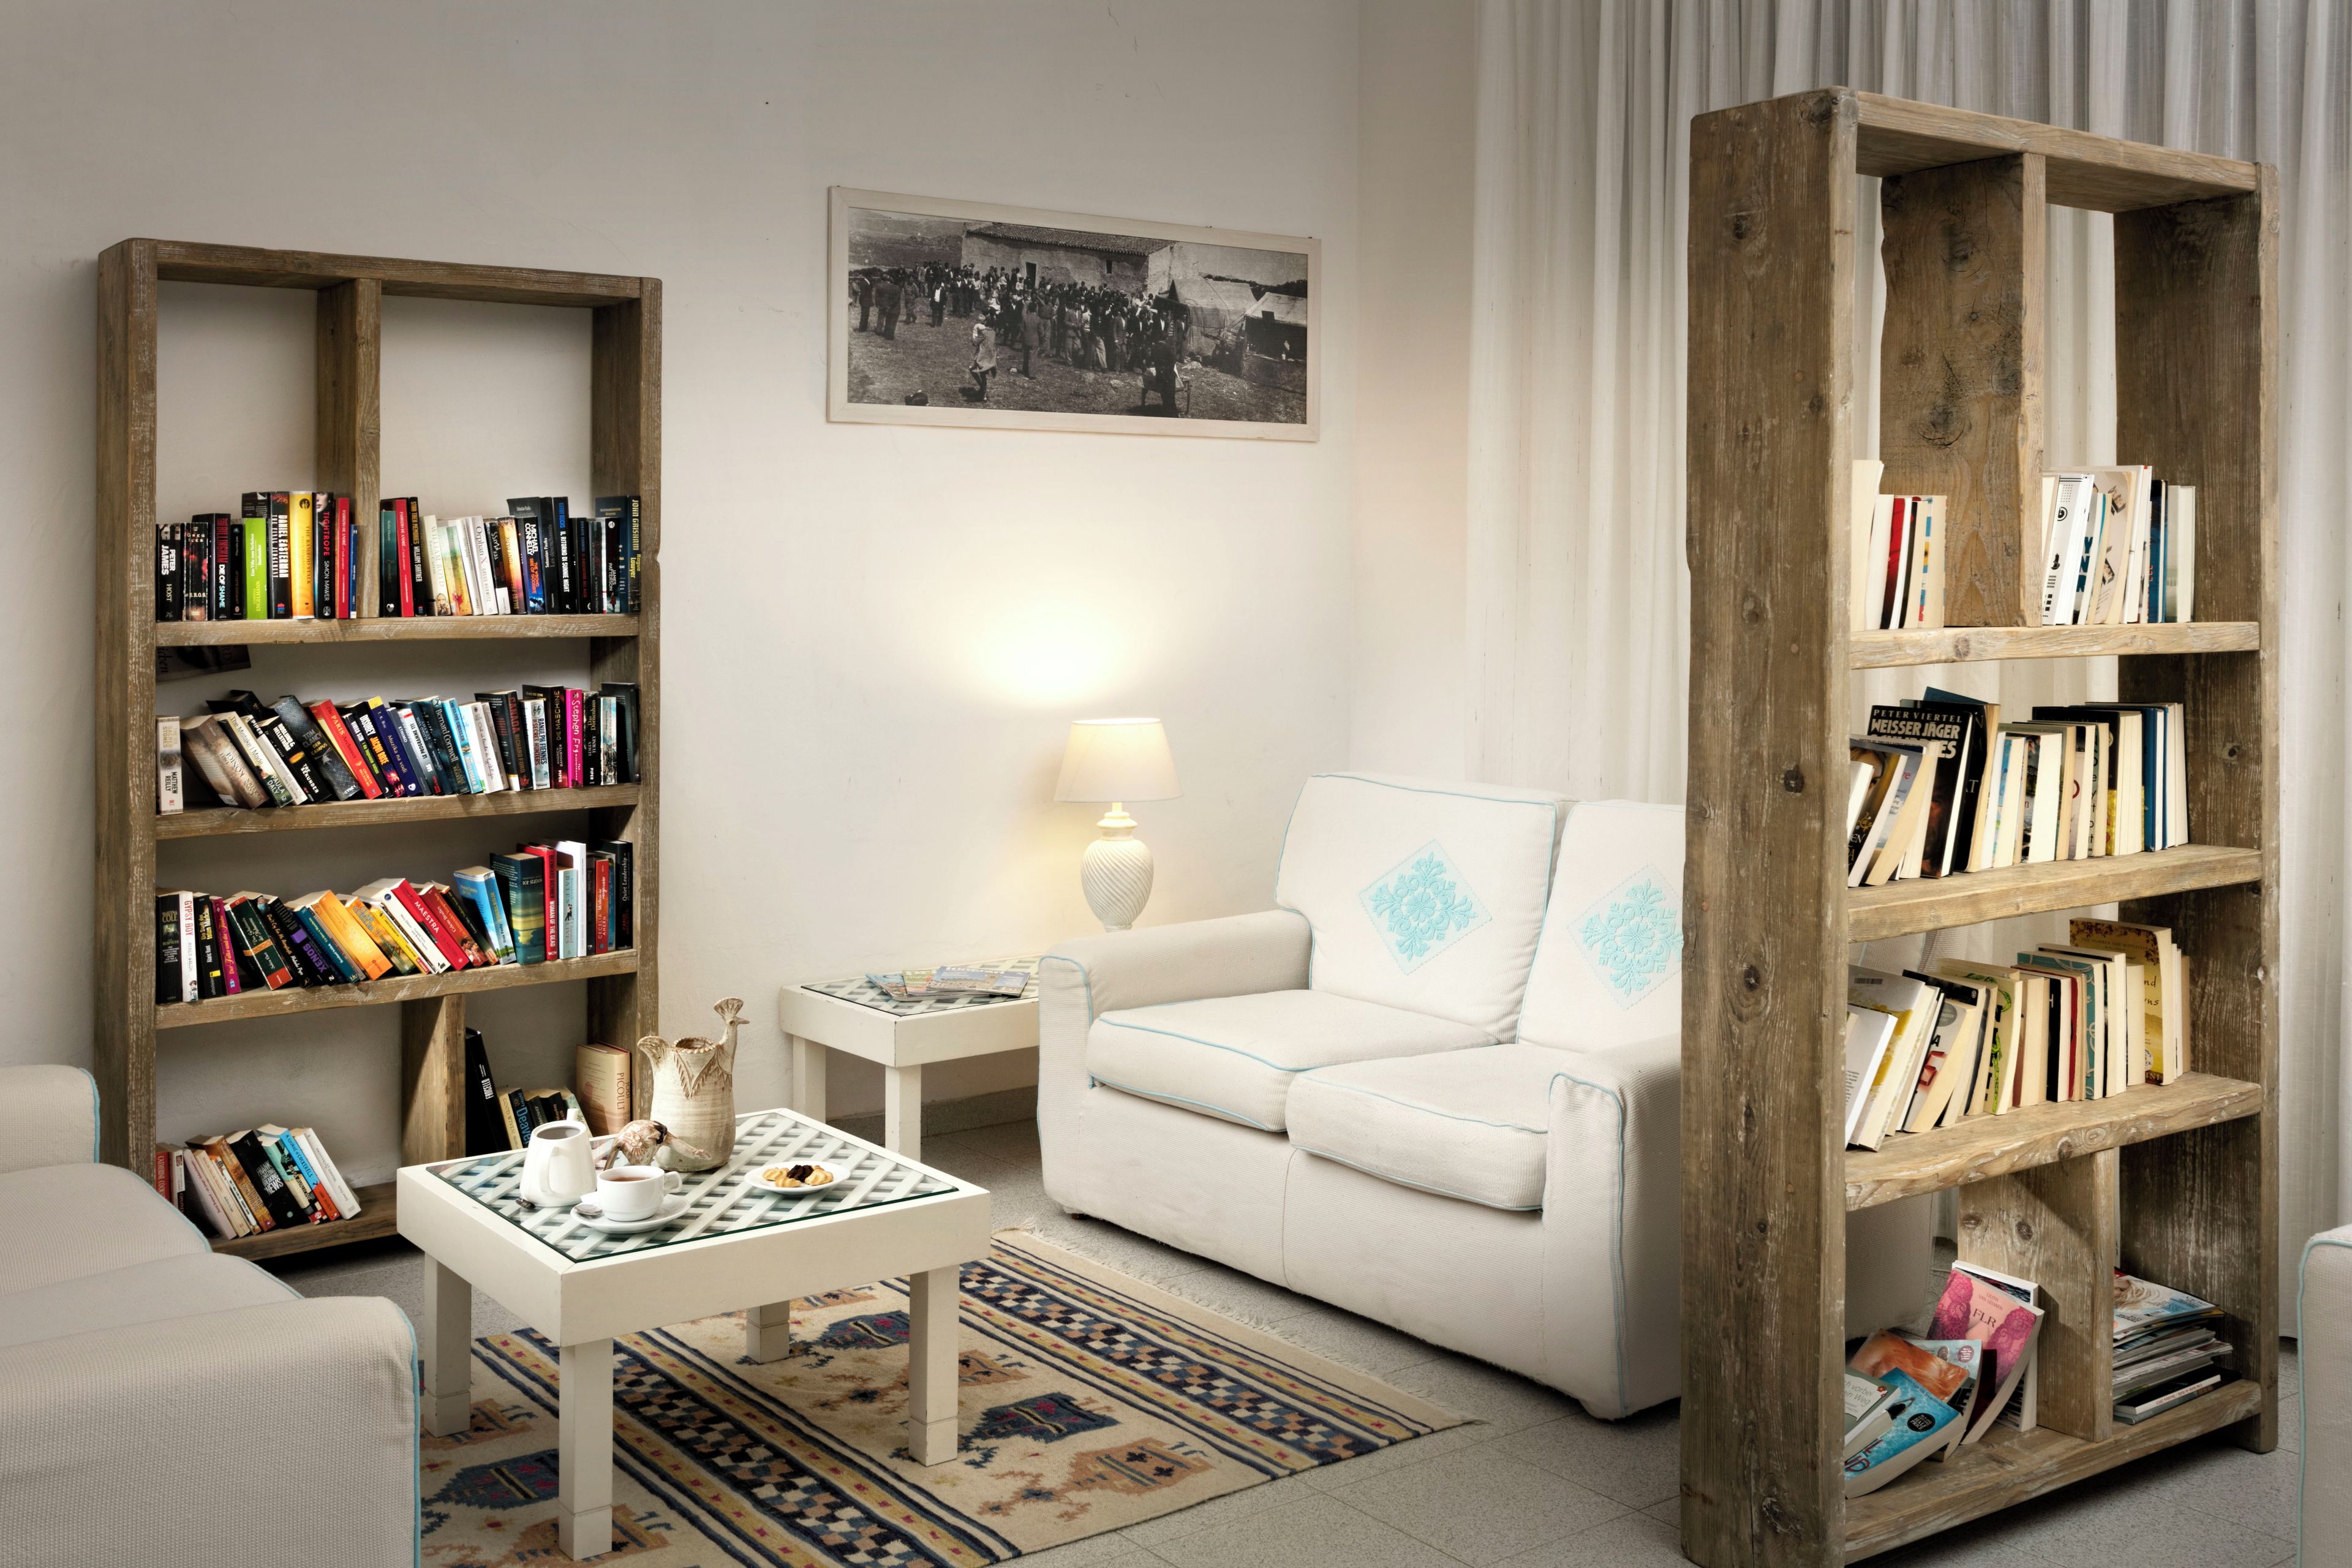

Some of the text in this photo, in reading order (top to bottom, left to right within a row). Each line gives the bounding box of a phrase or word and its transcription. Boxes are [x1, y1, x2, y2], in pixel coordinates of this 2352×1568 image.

[217, 526, 228, 564] BILLINGHAM
[278, 514, 289, 578] DANIEL EASTERMAN
[431, 526, 442, 561] WILLIAM
[475, 526, 485, 556] Orphan
[492, 532, 502, 551] FLUSS
[524, 522, 533, 556] CONNELLY
[219, 575, 225, 584] OF
[360, 714, 376, 736] DISOBEY
[571, 699, 581, 736] Stephen
[1873, 709, 1962, 723] PETER VIERTEL
[251, 719, 263, 736] PIPER
[277, 723, 292, 744] ROSLUND
[303, 729, 316, 739] TOM
[331, 715, 356, 760] PARIS Architect
[398, 726, 407, 743] ETHIMO
[435, 708, 459, 763] Bernard Cornwell
[508, 696, 520, 733] CANADA
[514, 733, 523, 759] RICHARD
[538, 718, 546, 742] RANULPH
[1871, 718, 1961, 739] WEISSER JÄGER
[231, 716, 263, 765] The Mistake Made
[273, 727, 291, 752] HELLSTRÖM
[302, 731, 322, 748] CLANCY
[311, 743, 328, 756] CAMPUS
[413, 730, 426, 755] PROGRAMME
[370, 736, 390, 766] JACQUI ROSE
[387, 735, 398, 753] Muzika
[399, 761, 408, 774] vodi
[226, 749, 246, 778] KÖNIGE
[303, 763, 311, 773] TRE
[465, 755, 476, 785] BOOTLEGGER
[267, 780, 280, 794] DALY
[271, 775, 285, 794] PAULA
[300, 767, 319, 794] SEKUNDER
[184, 900, 194, 935] GYPSY BOY
[219, 915, 228, 932] Taube
[360, 906, 375, 922] CLIVE
[414, 900, 440, 934] MAESTRA
[437, 905, 448, 921] Bradley
[242, 918, 255, 936] Geheimnis
[249, 918, 262, 937] Hebamme
[225, 950, 235, 966] Falke
[302, 943, 328, 973] XENOS
[516, 1107, 532, 1145] Deaver
[288, 1138, 298, 1153] CHORUS
[296, 1155, 313, 1178] COCKERELS
[255, 1161, 273, 1177] FRANK
[259, 1167, 276, 1182] SCHÄTZING
[262, 1172, 280, 1188] BREAKING
[264, 1177, 284, 1195] NEWS
[288, 1164, 312, 1201] SILVIA AVALLONE
[1986, 1292, 1999, 1303] LILITH
[1986, 1299, 2003, 1311] LEEUWEN
[1972, 1308, 1997, 1329] FLR
[1852, 1384, 1873, 1397] vorbei
[1854, 1394, 1871, 1407] Weg
[1910, 1420, 1924, 1431] PRICE
[1913, 1417, 1927, 1428] HALF
